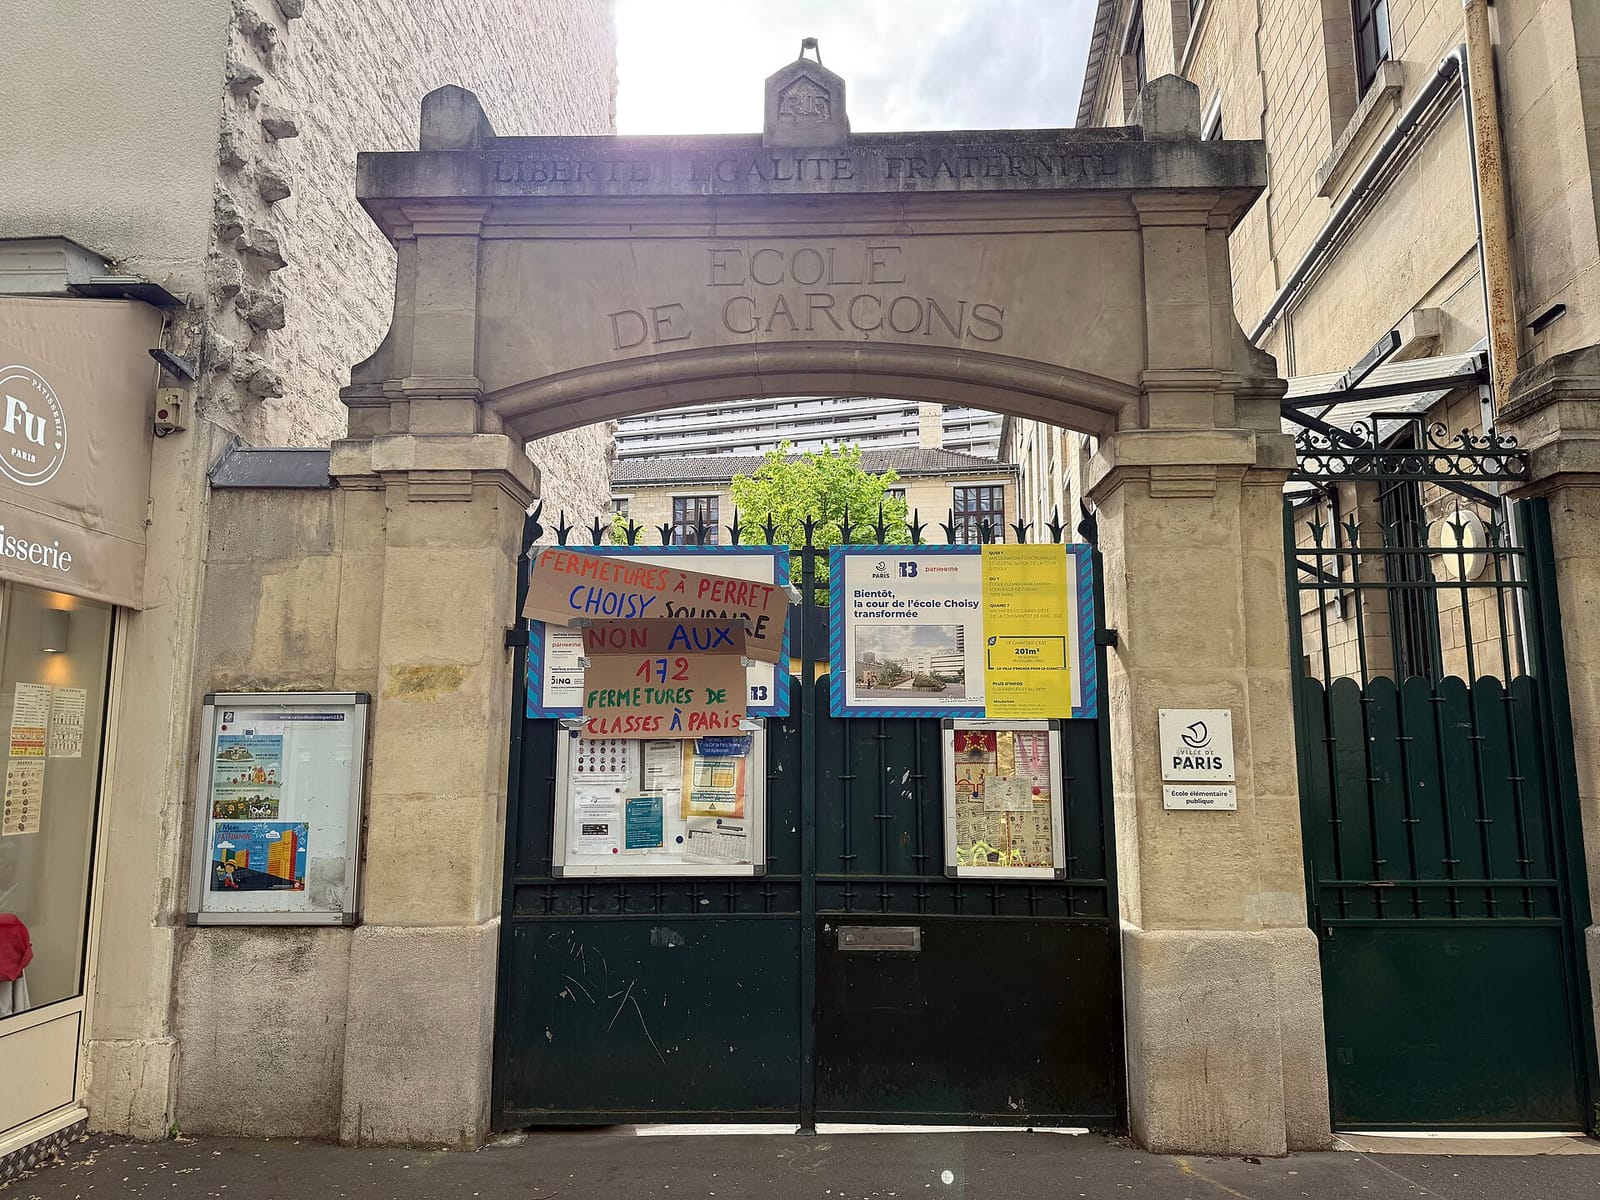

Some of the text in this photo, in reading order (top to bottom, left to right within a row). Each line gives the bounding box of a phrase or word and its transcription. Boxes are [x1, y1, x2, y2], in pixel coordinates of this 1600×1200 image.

[706, 246, 906, 287] ECOLE
[607, 293, 1005, 351] DE GARÇONS
[3, 394, 47, 447] Fu
[11, 447, 37, 464] PARIS
[540, 549, 775, 611] FERMETURES À PERRET
[899, 561, 918, 577] 13
[569, 585, 657, 619] CHOISY
[854, 589, 895, 599] Bientôt,
[854, 600, 863, 608] la
[892, 600, 905, 608] de
[908, 599, 941, 608] l'école
[944, 599, 980, 610] Choisy
[854, 609, 918, 618] transformée
[589, 624, 735, 650] NON AUX
[636, 657, 689, 684] 172
[587, 687, 694, 708] FERMETURES
[705, 687, 727, 705] DE
[750, 686, 768, 701] 13
[587, 714, 664, 735] CLASSES
[669, 707, 682, 731] À
[1173, 756, 1223, 770] PARIS
